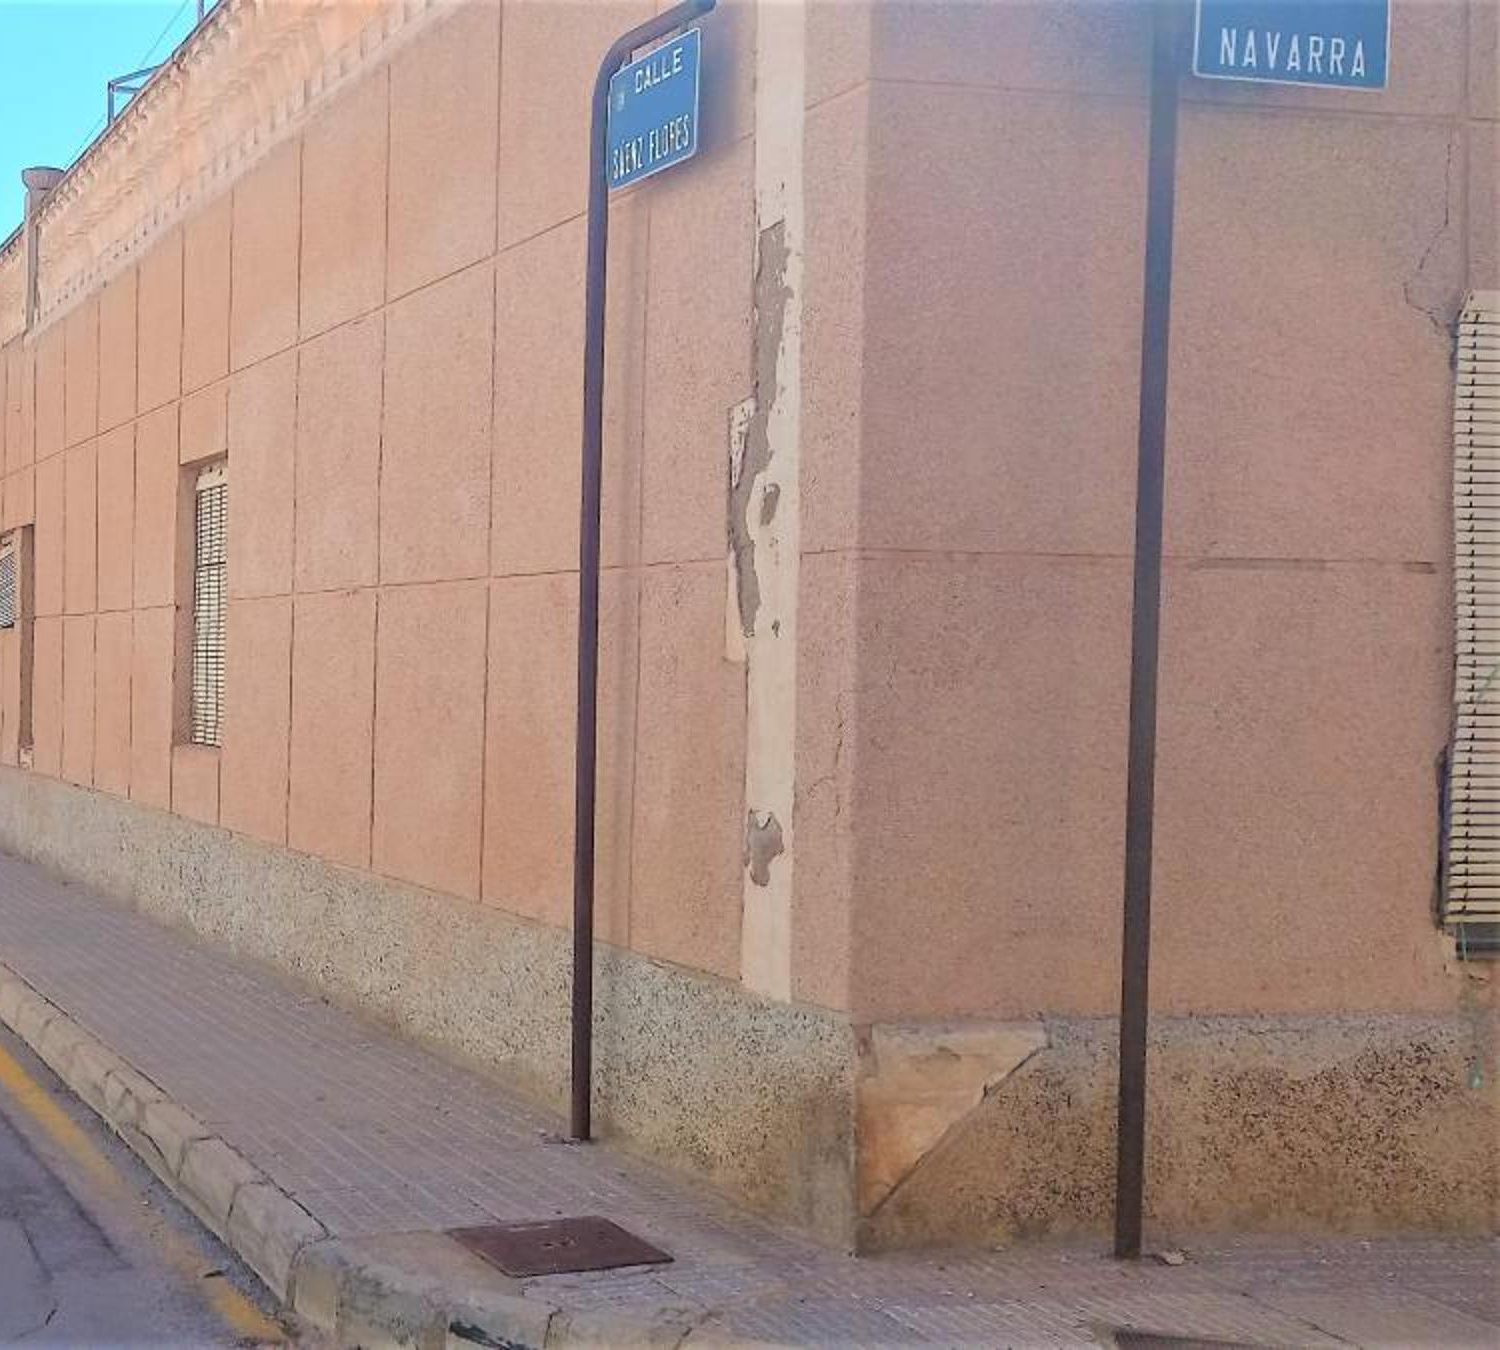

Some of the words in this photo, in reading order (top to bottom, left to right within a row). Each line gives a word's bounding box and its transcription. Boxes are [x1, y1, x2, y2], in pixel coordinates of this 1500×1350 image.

[635, 47, 683, 94] CALLE
[1219, 28, 1365, 77] NAVARRA
[649, 113, 689, 164] FLORES
